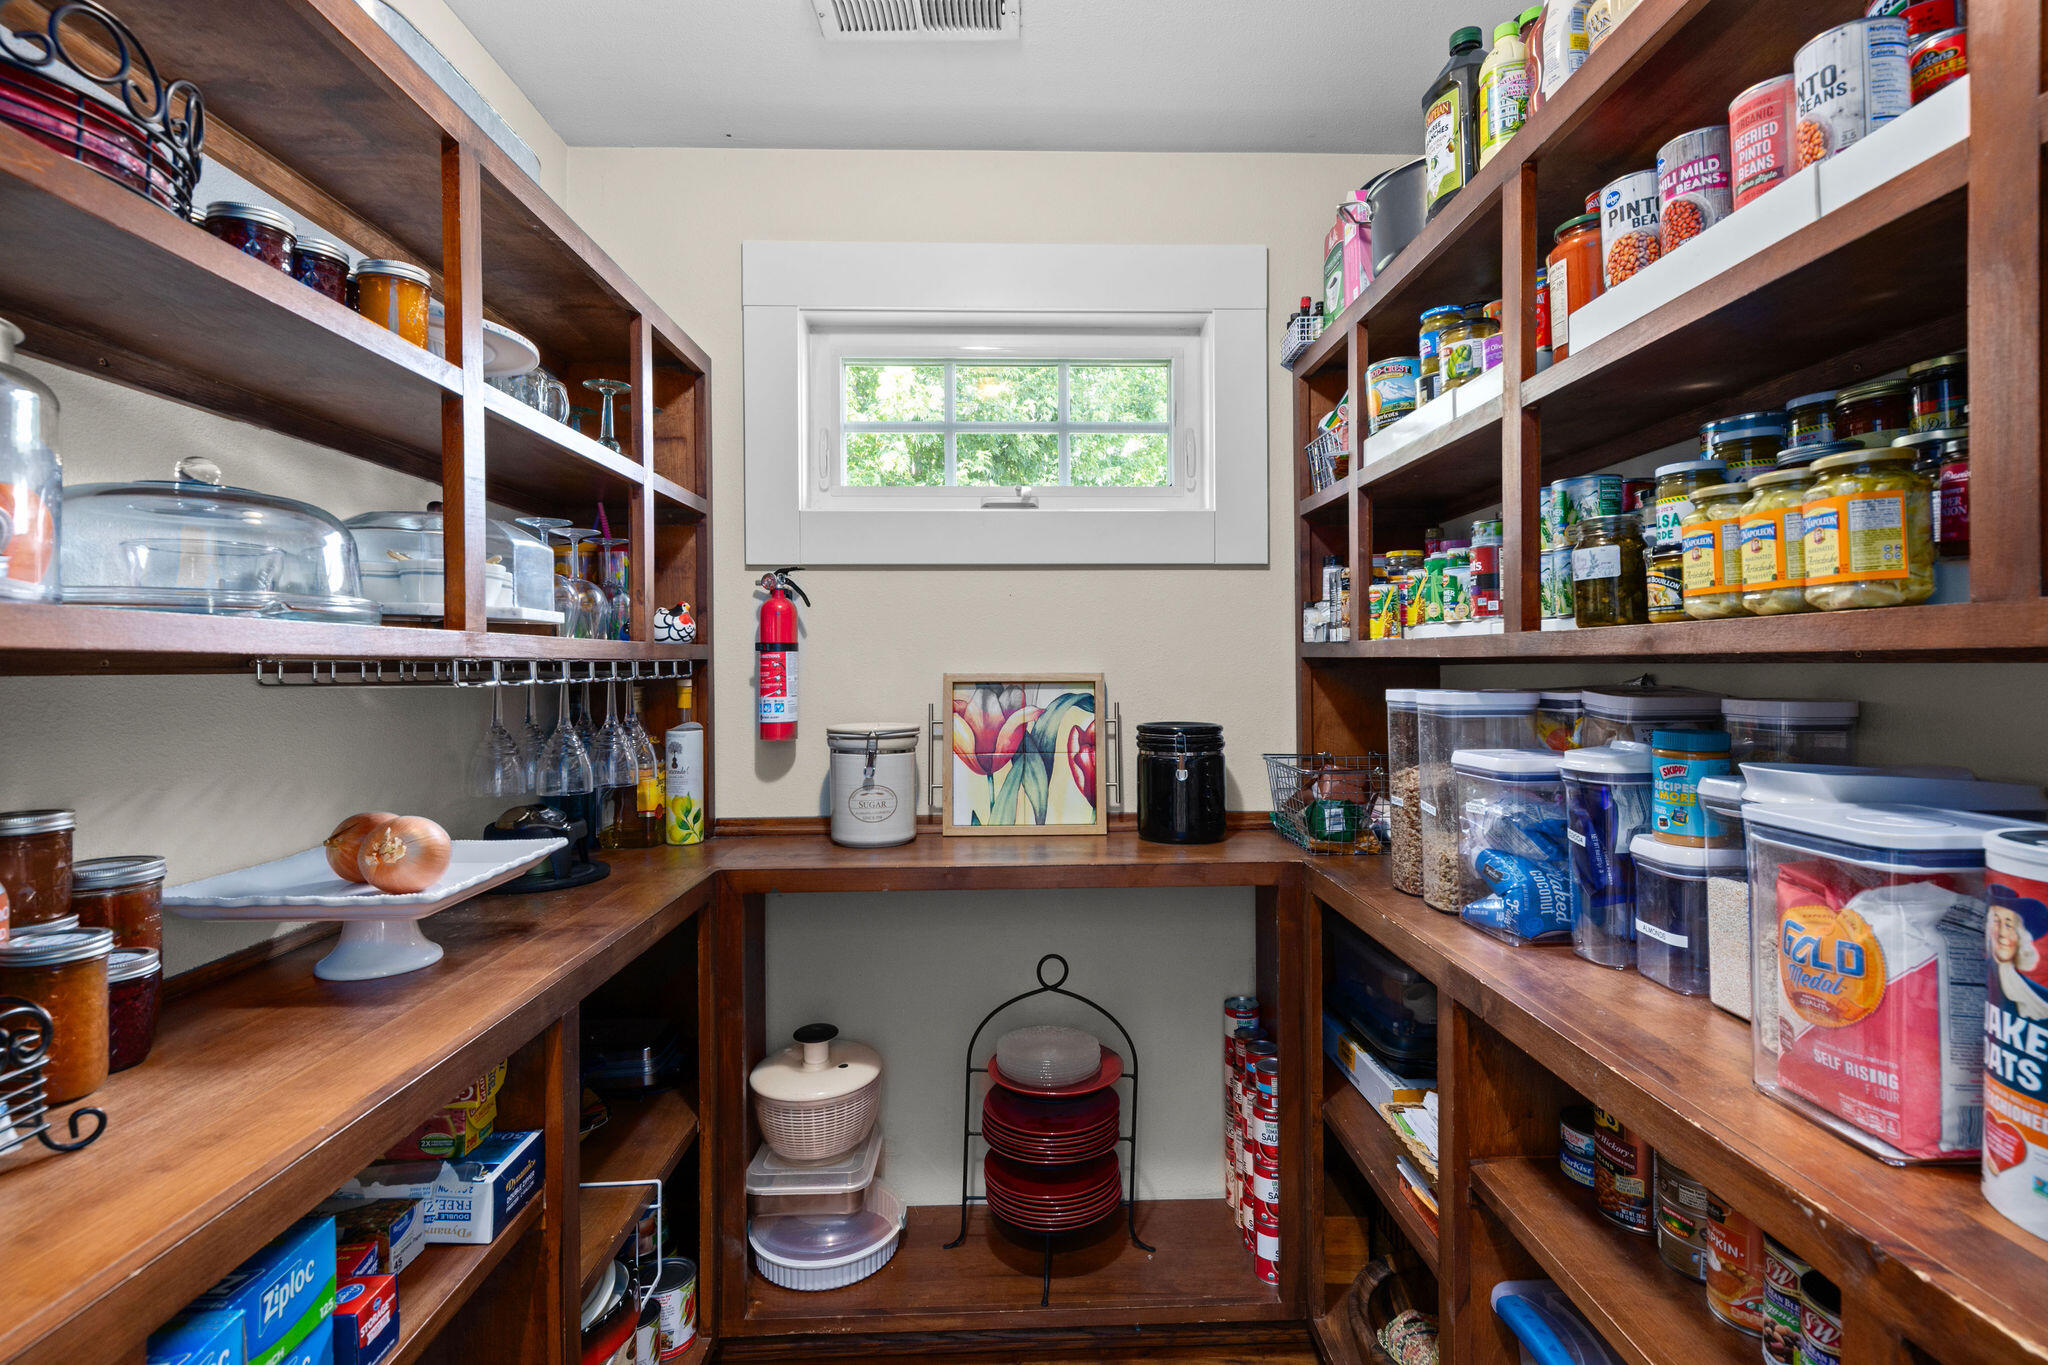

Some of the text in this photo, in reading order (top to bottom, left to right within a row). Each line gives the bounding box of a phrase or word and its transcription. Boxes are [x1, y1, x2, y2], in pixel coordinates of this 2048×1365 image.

[1799, 82, 1848, 117] BEANS
[1735, 121, 1778, 151] REFRIED
[1738, 139, 1772, 165] PINTO
[1680, 157, 1721, 181] MILD
[1738, 153, 1775, 182] BEANS
[1676, 172, 1721, 195] BEANS
[1651, 575, 1681, 590] BOUILLON
[1662, 764, 1687, 778] SKIPPY
[1654, 780, 1697, 794] RECIPES
[1658, 792, 1697, 804] MORE
[858, 800, 887, 809] SUGAR
[1642, 924, 1666, 941] ALMONDS
[1782, 918, 1867, 979] GOLD
[1788, 964, 1844, 995] Medal
[1812, 1047, 1842, 1071] SELF
[1844, 1060, 1900, 1091] RISING
[1864, 1083, 1900, 1104] FLOUR
[1601, 1135, 1630, 1158] Hickory
[263, 1260, 315, 1325] Ziploc
[319, 1298, 334, 1319] 125
[360, 1300, 391, 1339] STORAGE
